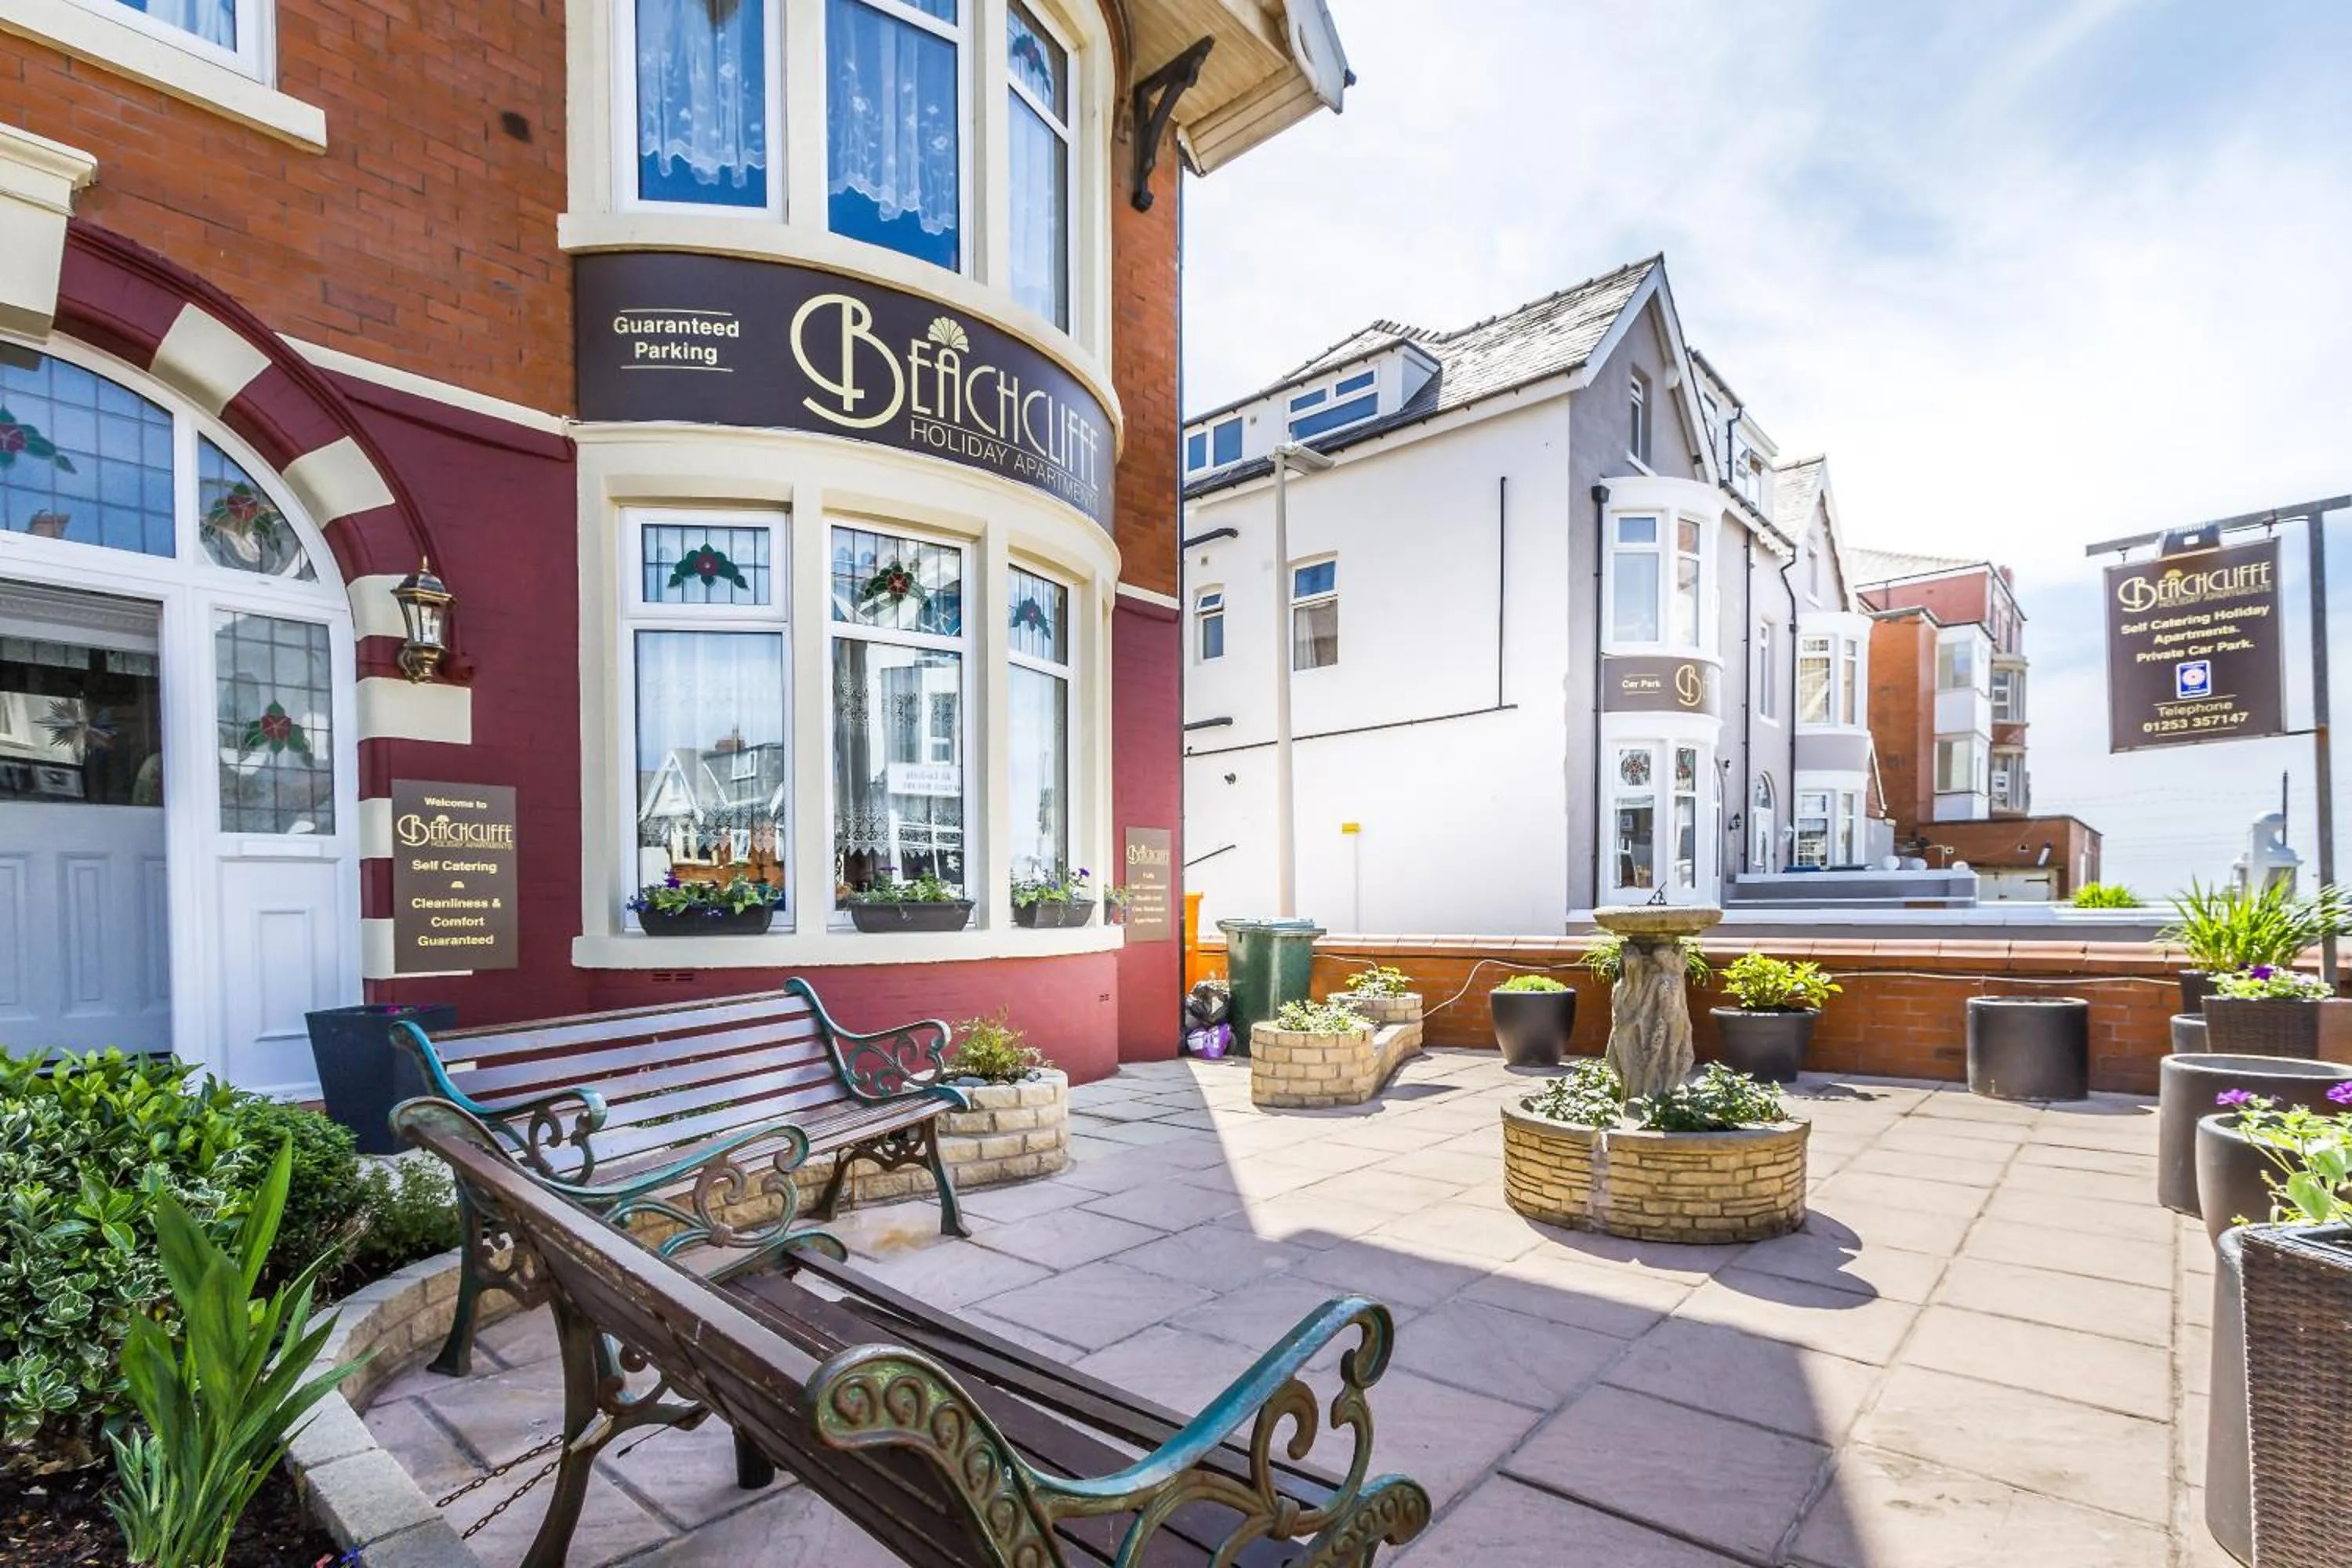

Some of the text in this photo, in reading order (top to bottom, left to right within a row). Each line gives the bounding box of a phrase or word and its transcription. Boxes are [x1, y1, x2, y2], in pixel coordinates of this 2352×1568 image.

[612, 315, 740, 338] Guaranteed
[634, 341, 718, 365] Parking
[910, 420, 1098, 508] HOLIDAY APARTMENT
[2121, 604, 2270, 635] Self Catering Holiday
[2136, 648, 2185, 663] Private
[2188, 644, 2212, 656] Car
[2157, 702, 2233, 718] Telephone
[2143, 711, 2249, 733] 01253 357147
[424, 797, 488, 809] Welcome to
[412, 859, 498, 874] Self Catering
[412, 898, 502, 909] Cleanliness &
[431, 916, 485, 927] Comfort
[418, 935, 495, 947] Guaranteed
